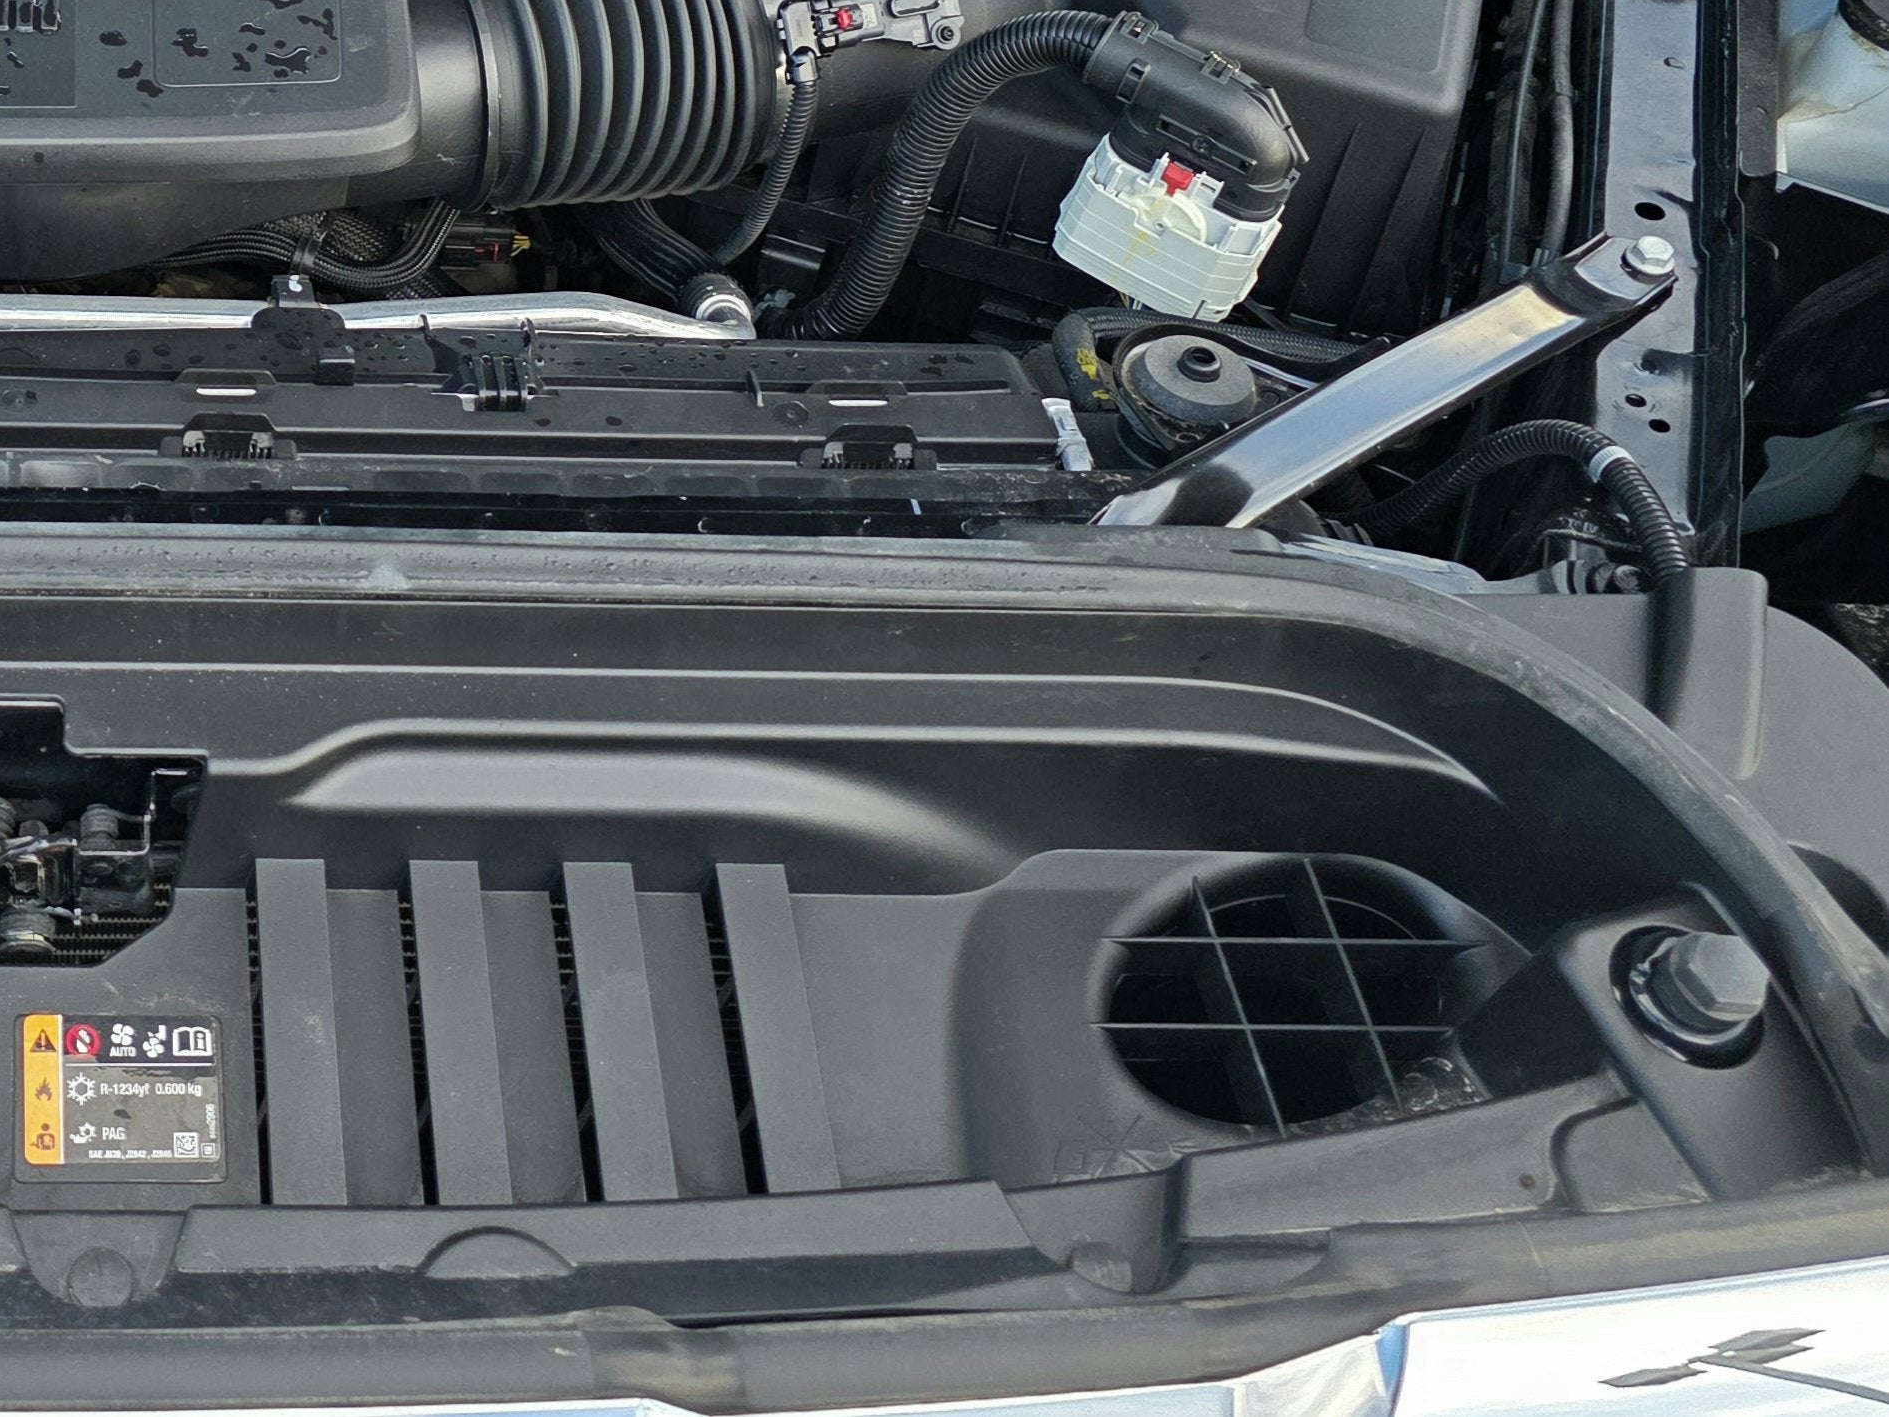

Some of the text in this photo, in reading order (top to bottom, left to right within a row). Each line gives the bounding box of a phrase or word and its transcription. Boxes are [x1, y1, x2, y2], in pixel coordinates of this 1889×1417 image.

[109, 1046, 137, 1057] AUTO
[100, 1083, 202, 1098] R-1234yf 0.600 kg
[102, 1127, 127, 1140] PAG
